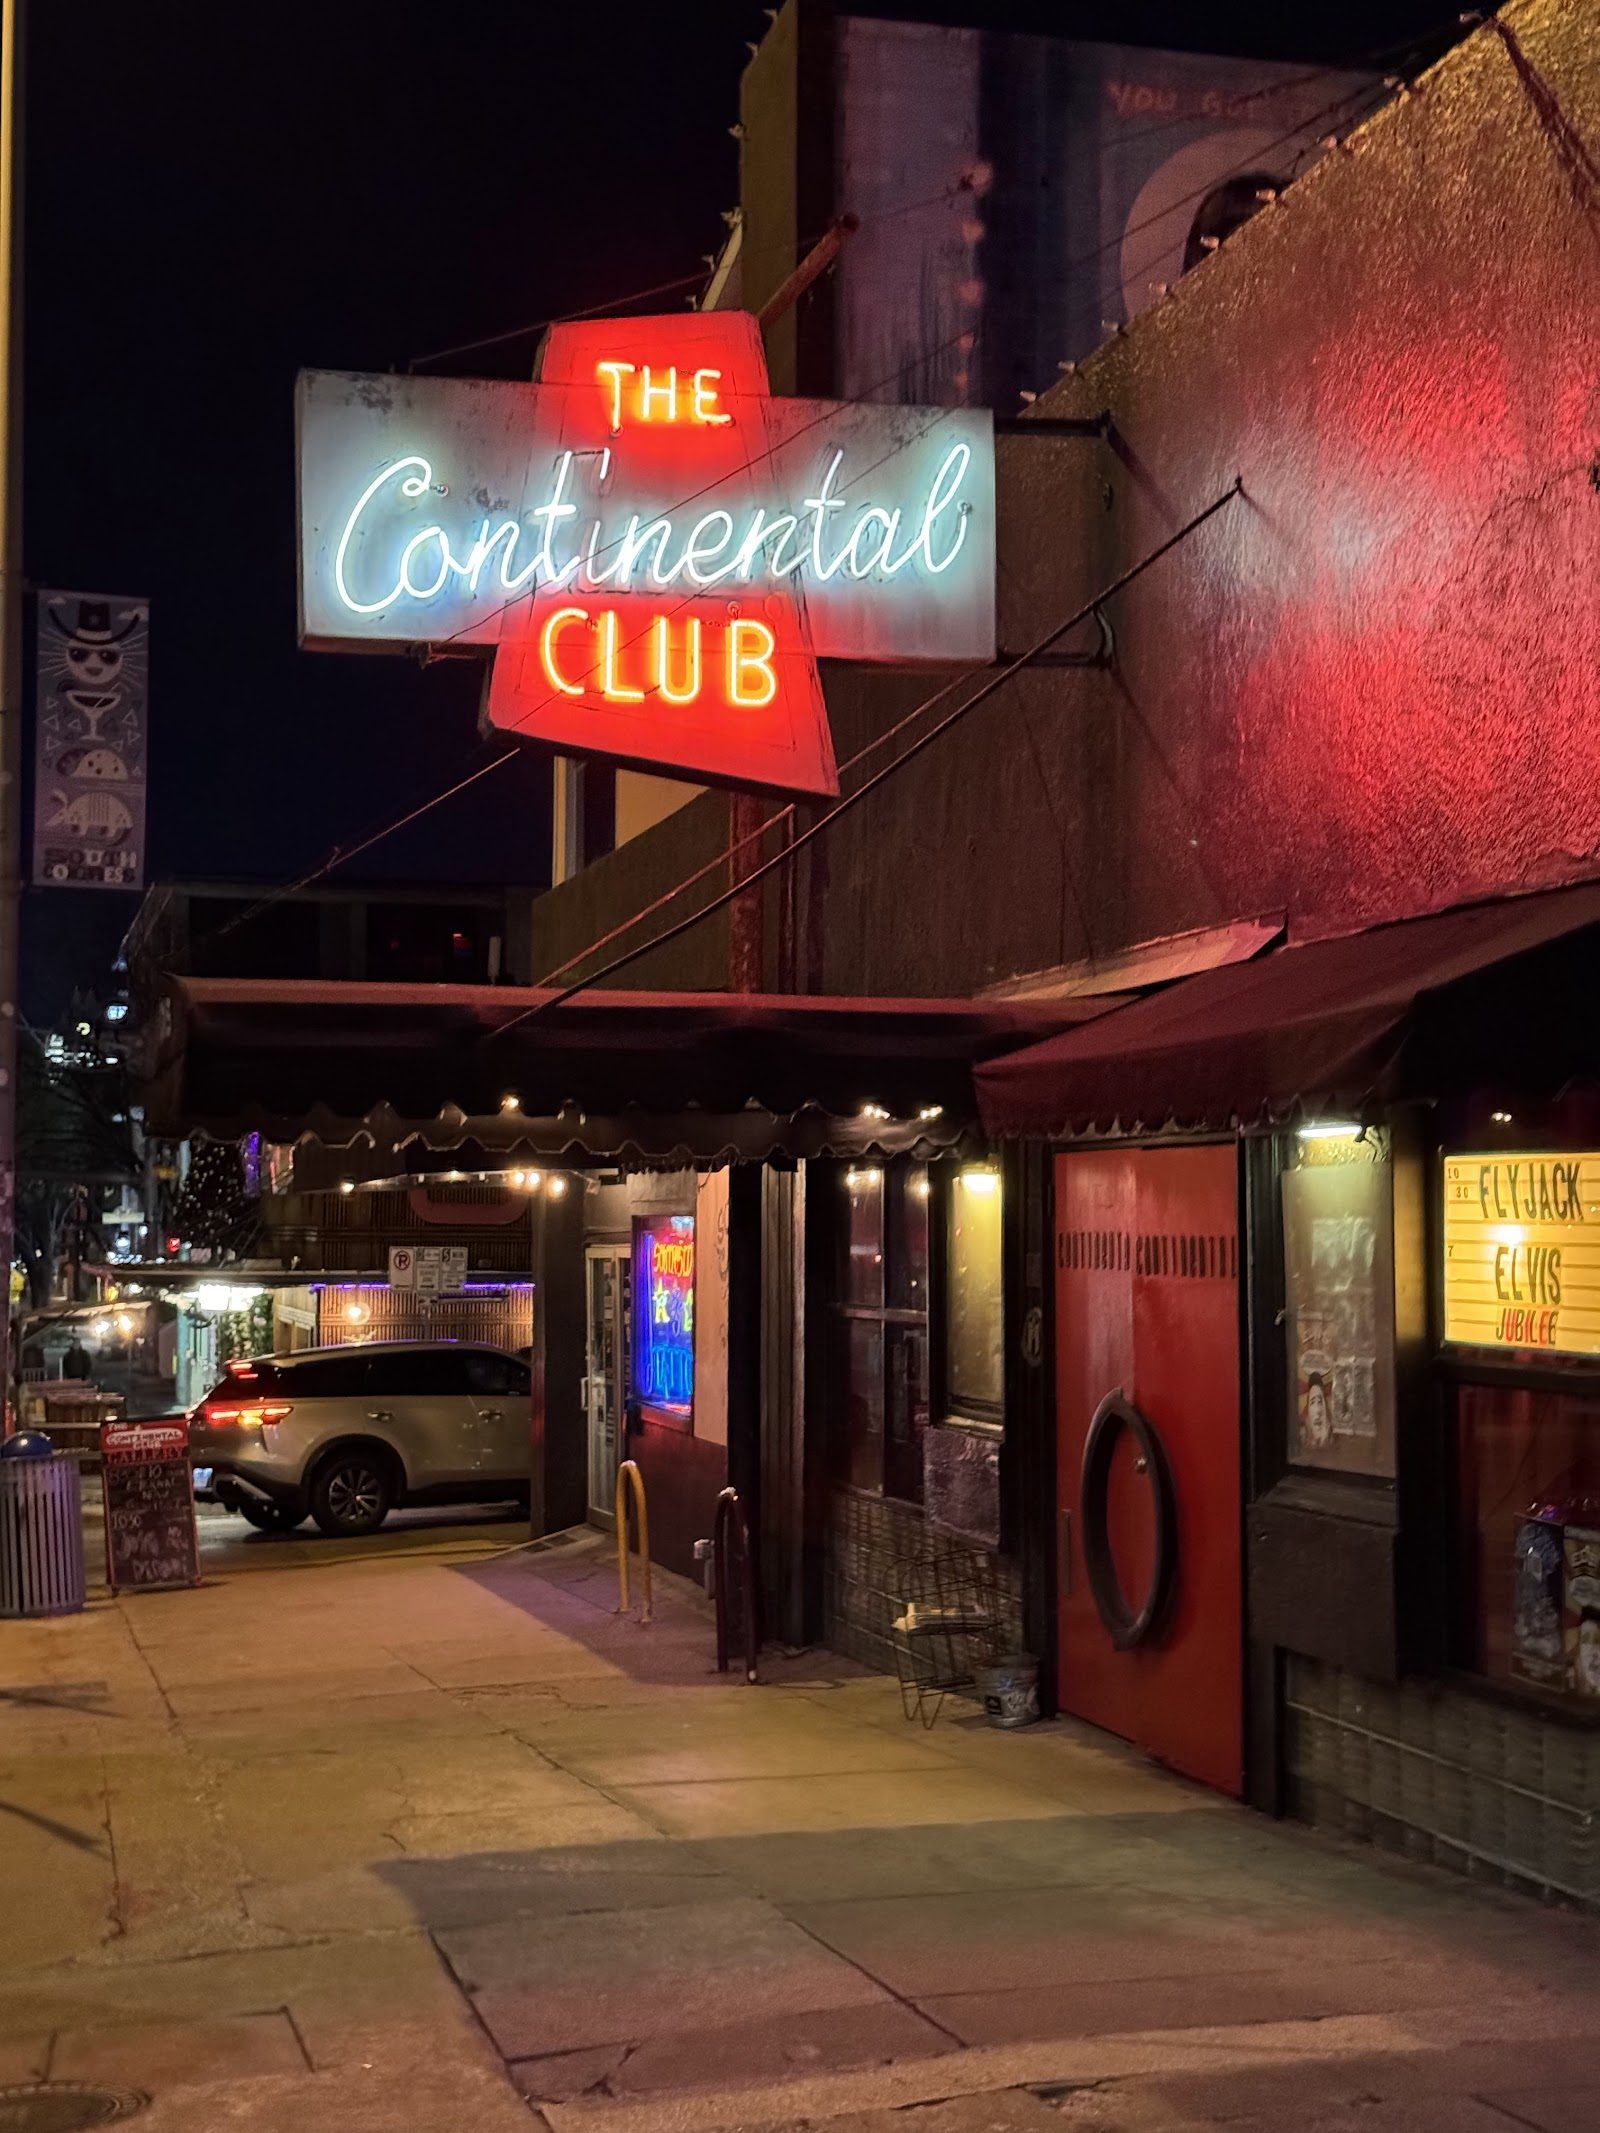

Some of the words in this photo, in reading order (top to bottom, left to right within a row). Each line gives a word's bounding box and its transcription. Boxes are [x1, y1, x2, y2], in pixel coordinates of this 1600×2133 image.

[596, 361, 734, 431] THE
[541, 608, 778, 706] CLUB
[1479, 1161, 1584, 1221] FLYJACK
[1447, 1245, 1454, 1258] 7
[1495, 1246, 1562, 1306] ELVIS
[1495, 1307, 1560, 1346] JUBILEE
